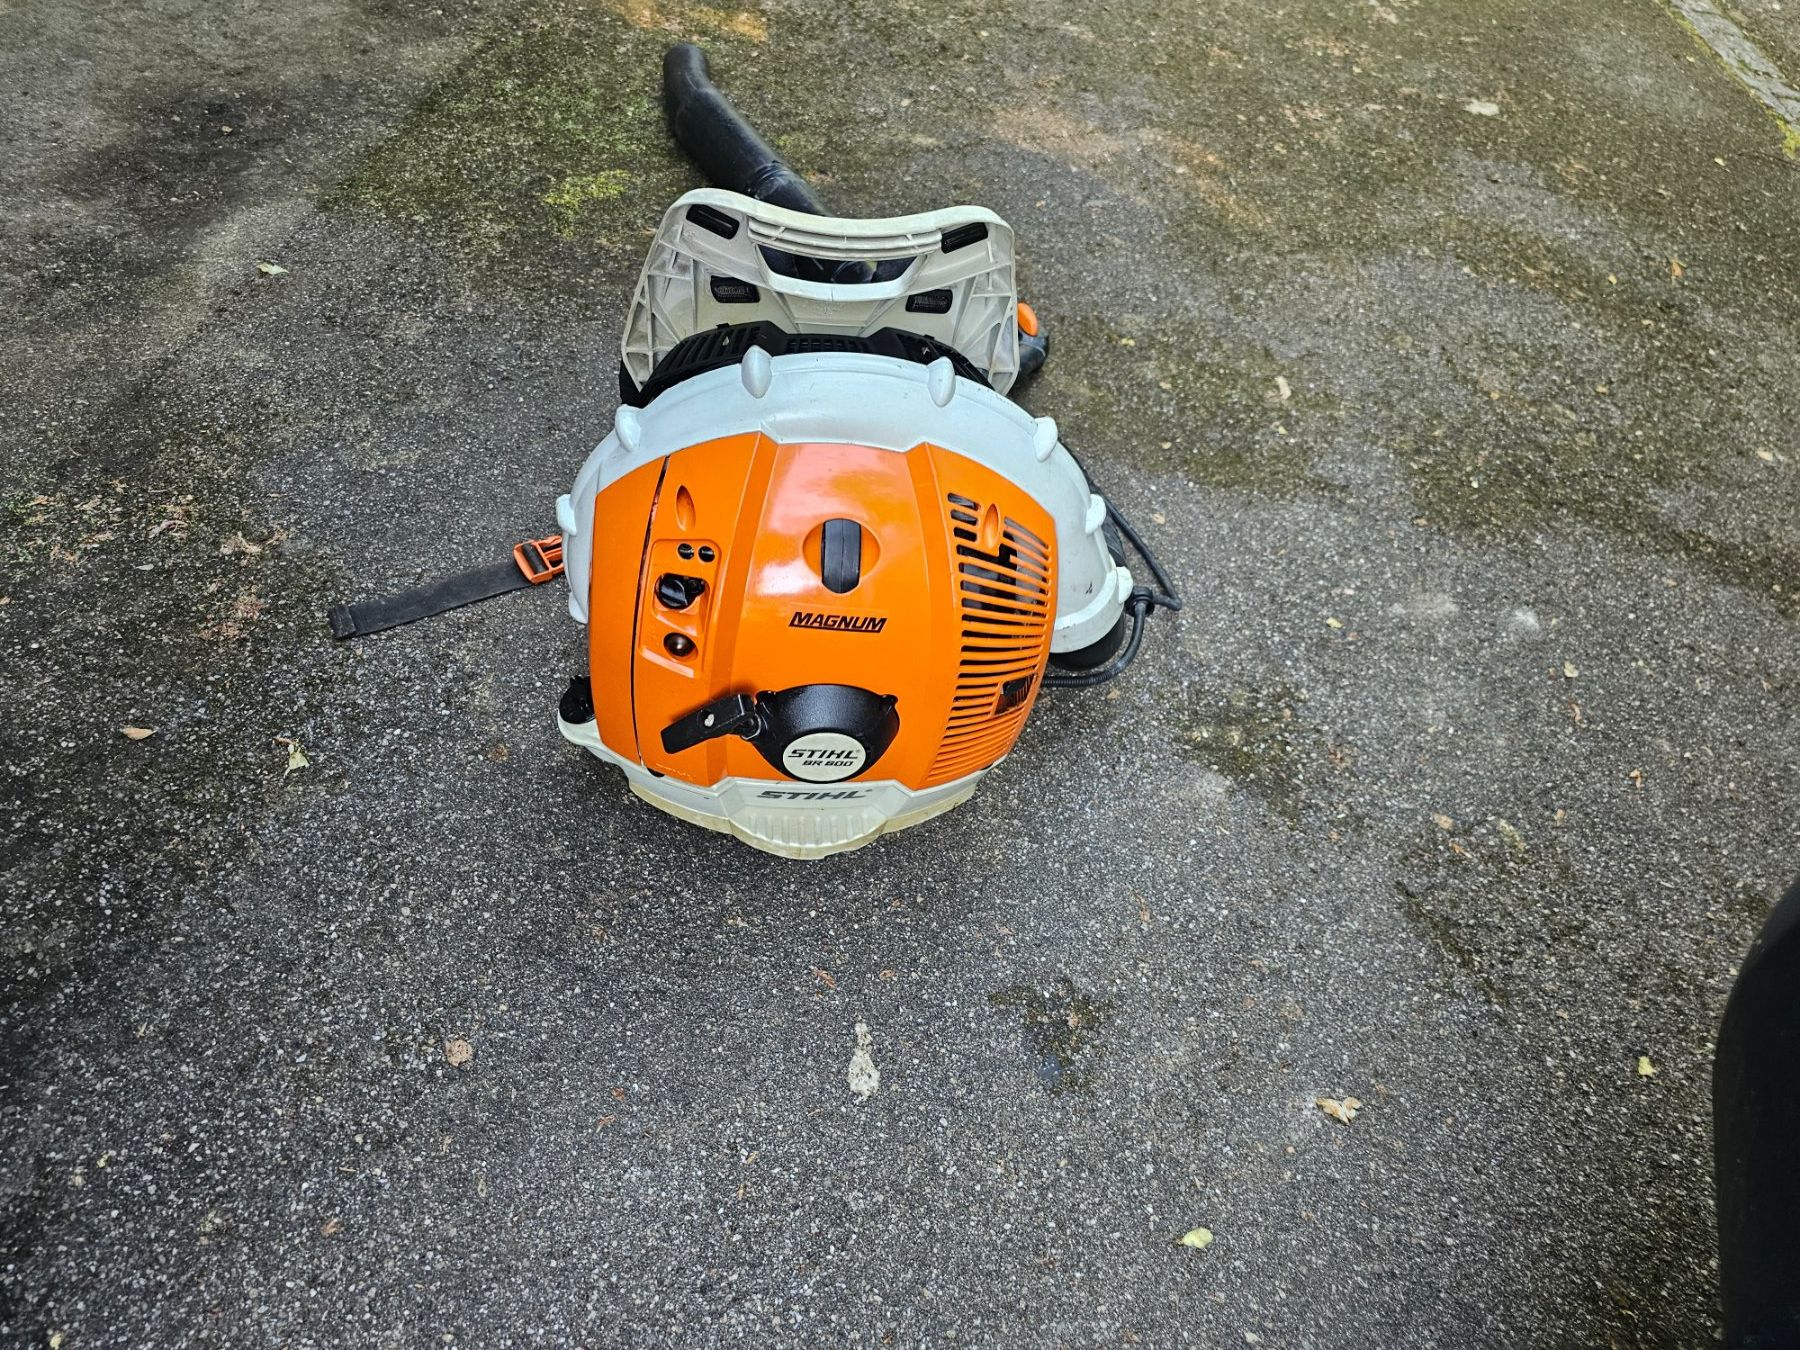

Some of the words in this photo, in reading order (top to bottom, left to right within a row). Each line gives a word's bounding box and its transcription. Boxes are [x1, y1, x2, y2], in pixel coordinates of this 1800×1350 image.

[789, 611, 887, 633] MAGNUM
[788, 749, 858, 759] STIHL
[757, 790, 866, 800] STIHL
